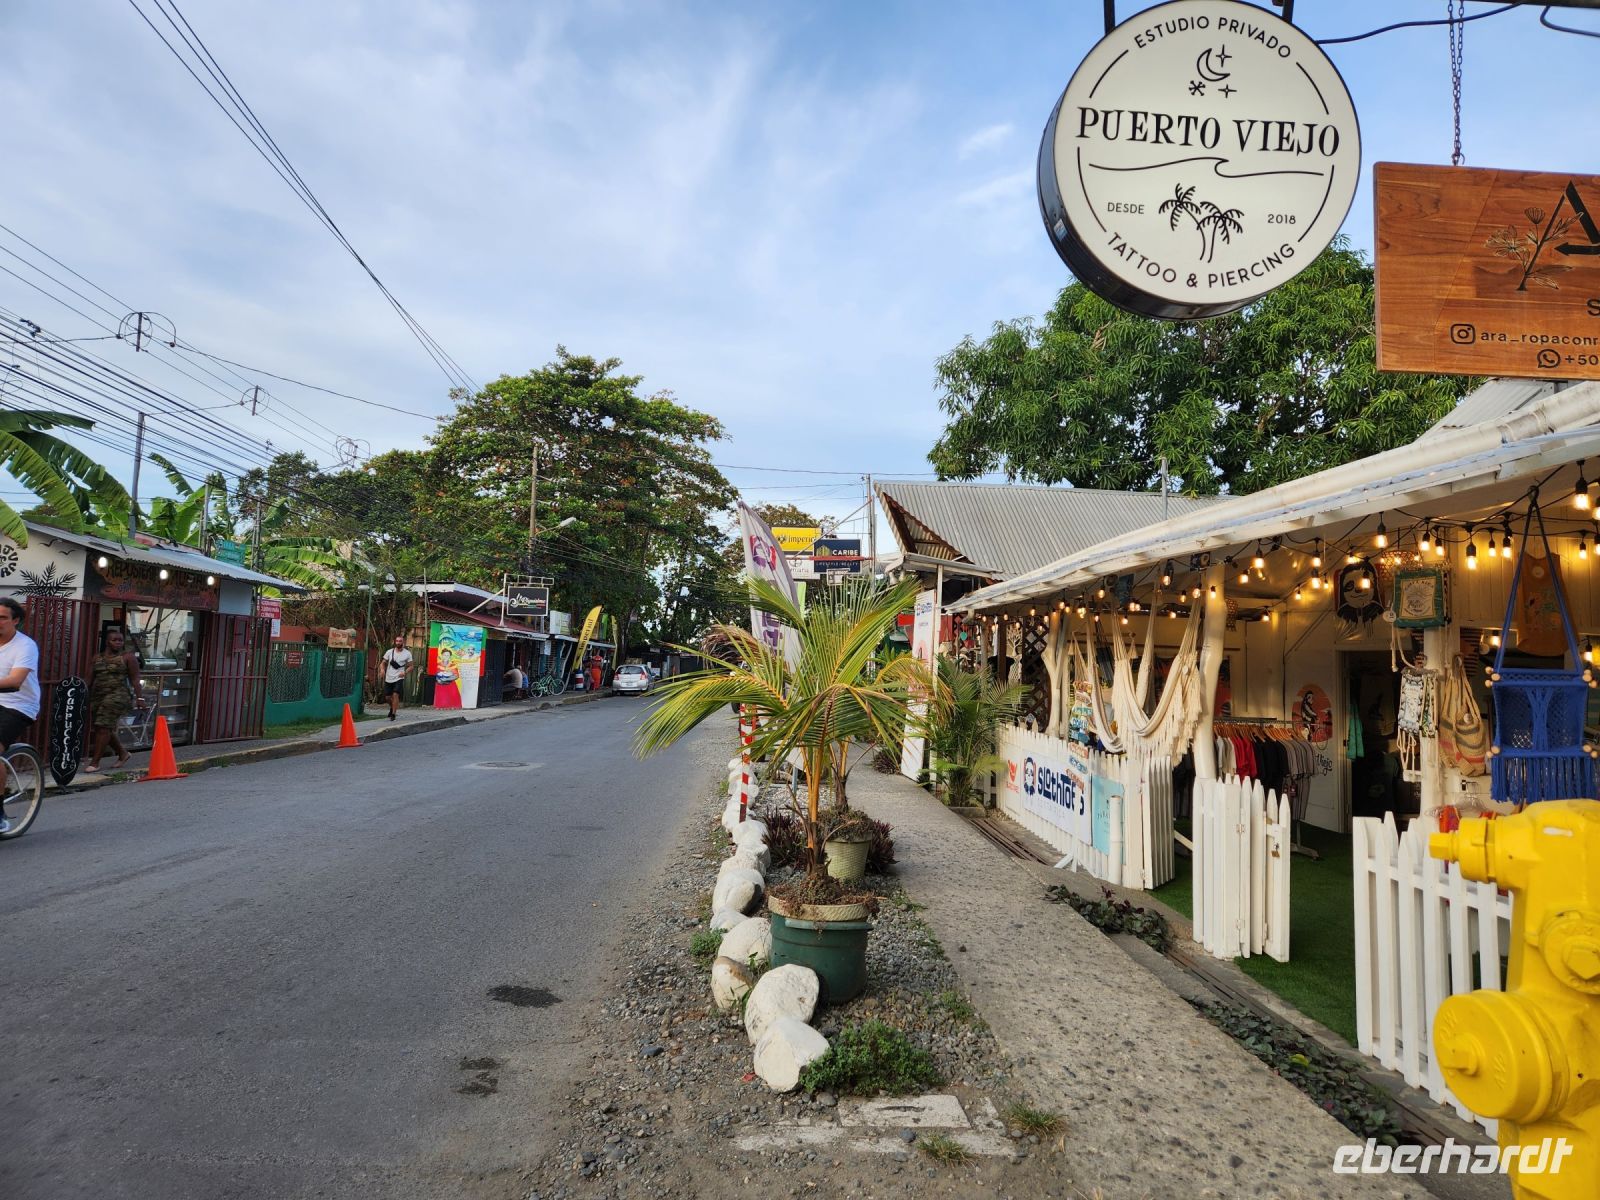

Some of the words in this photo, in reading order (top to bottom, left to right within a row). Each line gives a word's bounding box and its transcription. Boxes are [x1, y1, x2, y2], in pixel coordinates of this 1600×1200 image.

[1133, 15, 1210, 50] ESTUDIO
[1217, 17, 1292, 59] PRIVADO
[1075, 106, 1221, 150] PUERTO
[1232, 119, 1340, 157] VIEJO
[1106, 201, 1145, 215] DESDE
[1267, 213, 1297, 225] 2018
[1107, 231, 1177, 284] TATTOO
[1186, 272, 1198, 288] &
[1207, 242, 1295, 289] PIERCING
